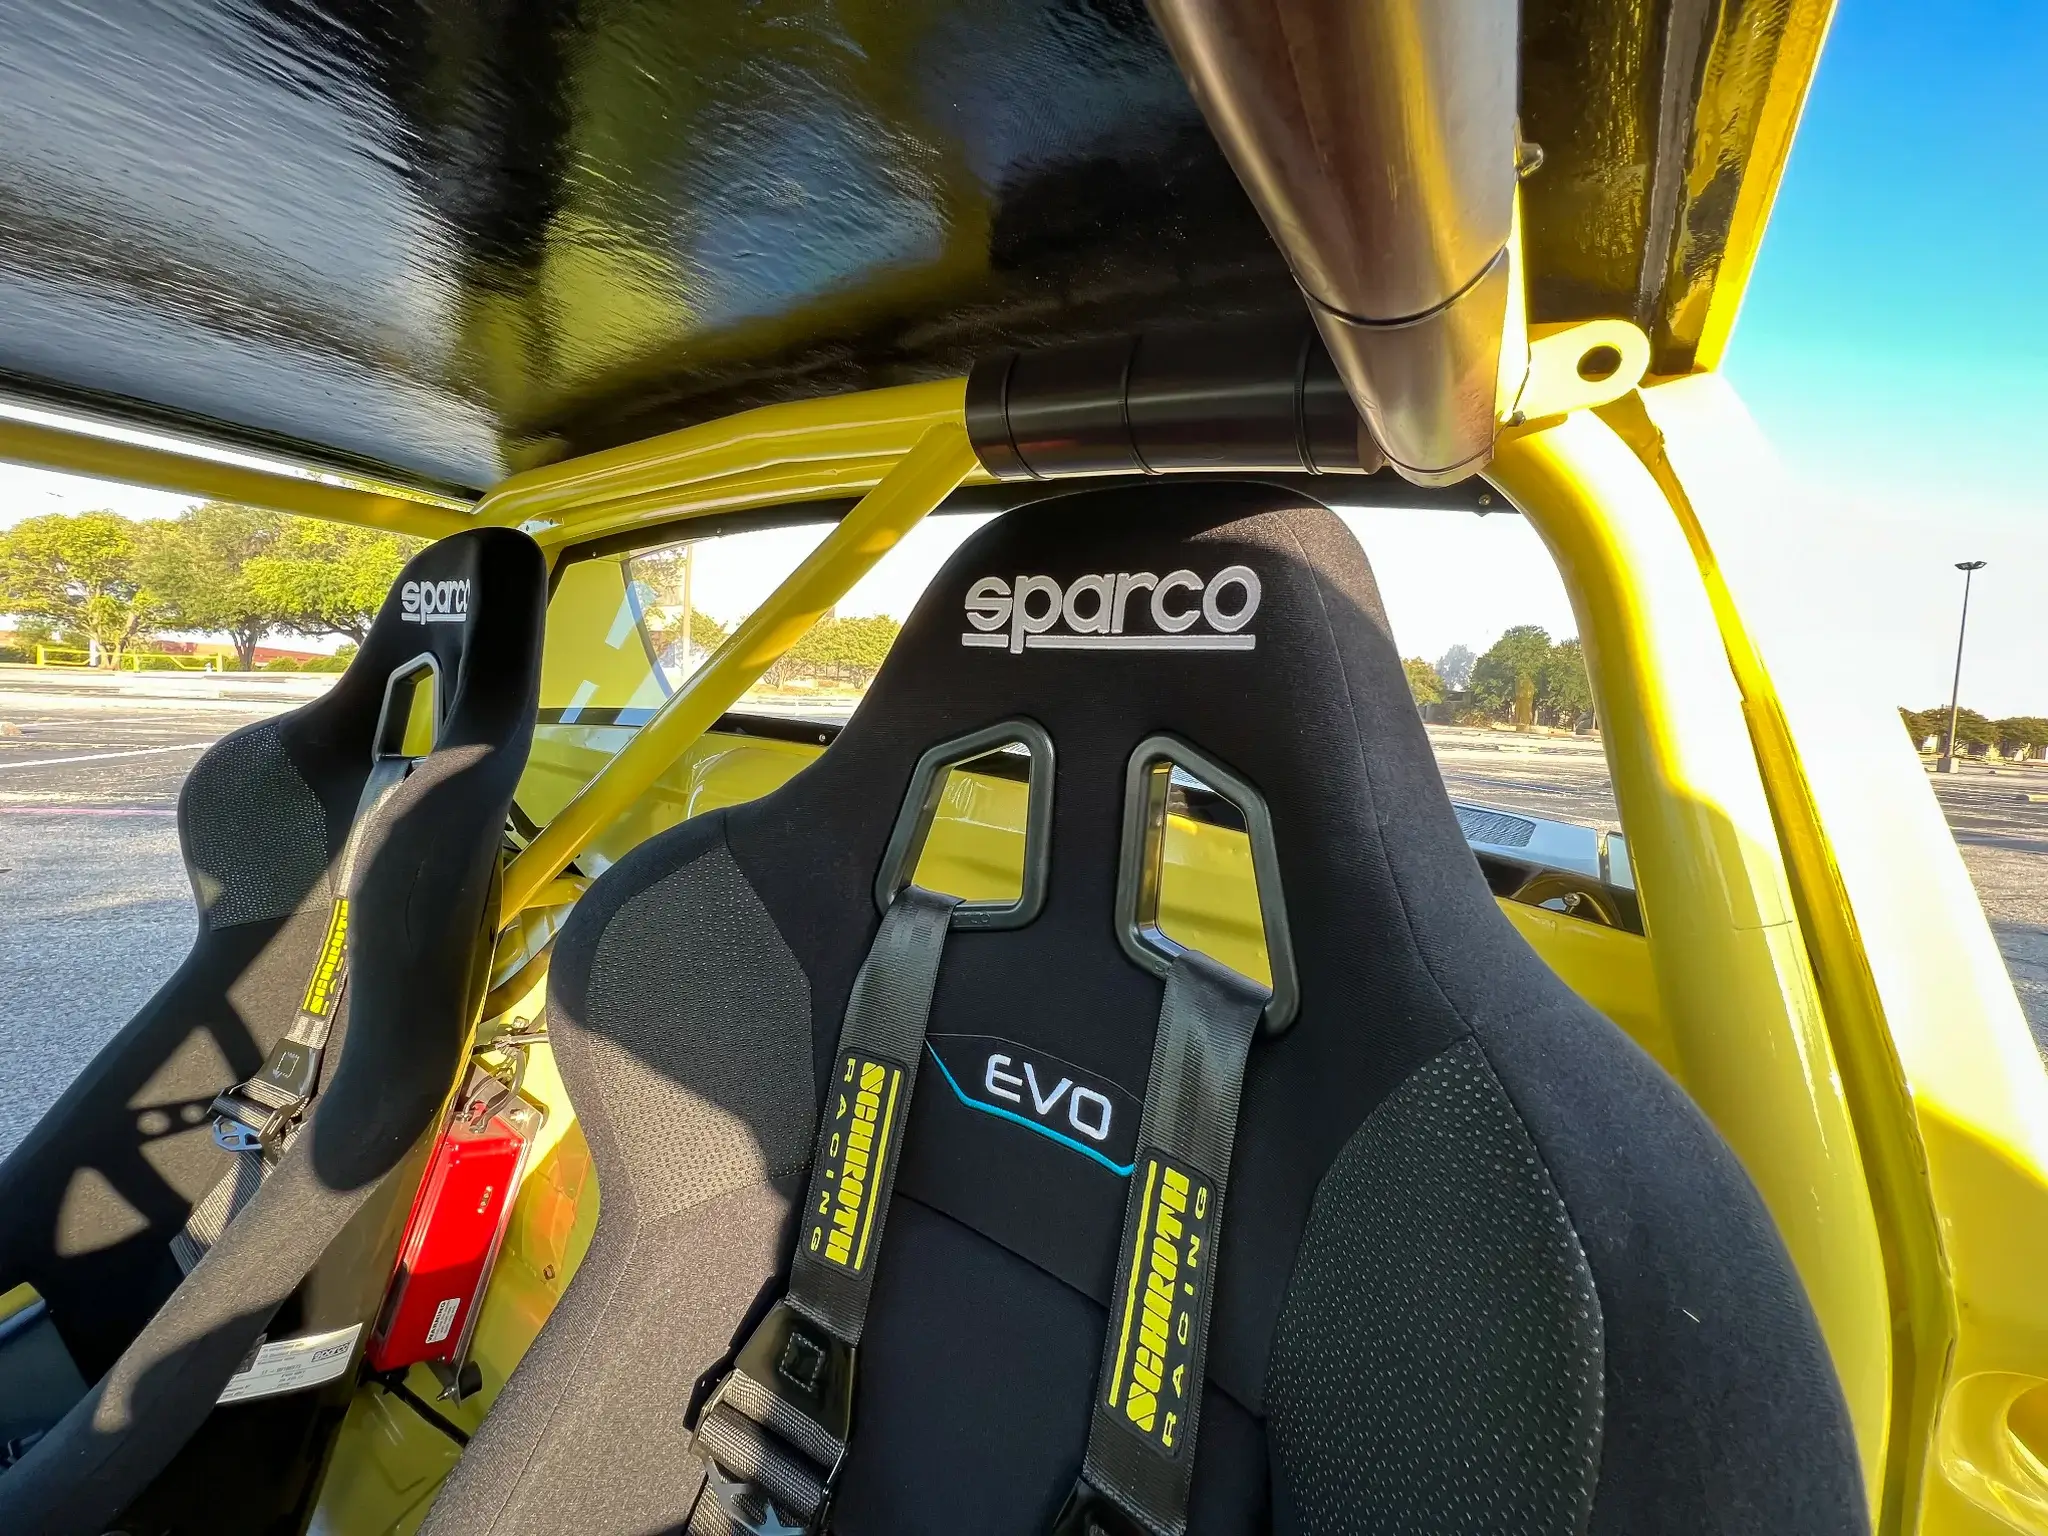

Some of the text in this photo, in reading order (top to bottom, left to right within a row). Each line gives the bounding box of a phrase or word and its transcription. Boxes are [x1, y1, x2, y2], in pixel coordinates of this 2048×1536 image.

[963, 564, 1262, 654] sparco
[810, 1057, 857, 1251] RACING
[825, 1061, 886, 1266] SCHROTH
[985, 1053, 1112, 1140] EVO
[427, 1301, 446, 1341] WARNING
[1126, 1166, 1190, 1433] SCHROTH
[1162, 1186, 1208, 1448] RACING
